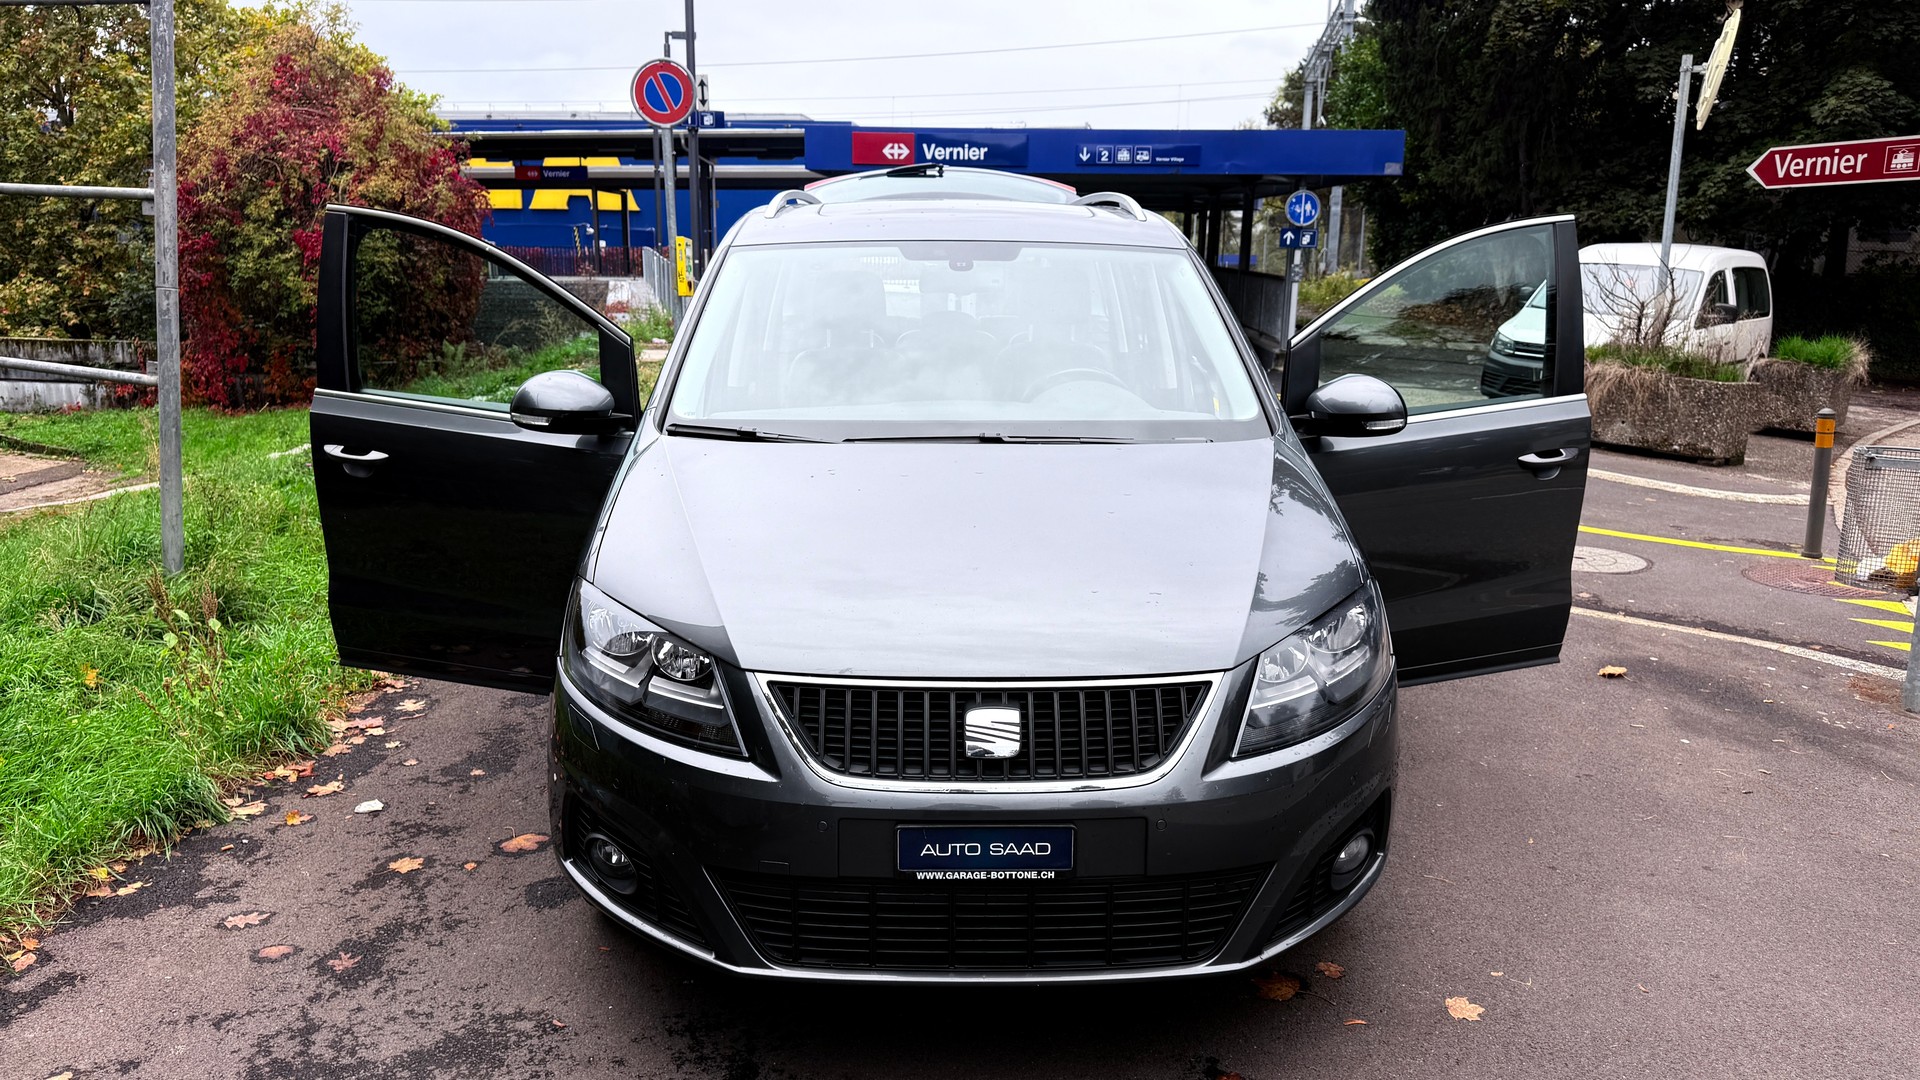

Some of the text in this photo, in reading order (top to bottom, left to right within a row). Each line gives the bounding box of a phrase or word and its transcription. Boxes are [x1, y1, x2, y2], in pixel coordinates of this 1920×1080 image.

[922, 143, 988, 162] Vernier
[1100, 150, 1109, 162] 2
[1774, 147, 1869, 179] Vernier
[542, 169, 570, 178] Vernier
[920, 842, 1051, 857] AUTO SAAD
[916, 871, 1055, 880] WWW.GARAGE-BOTTONE.CH
